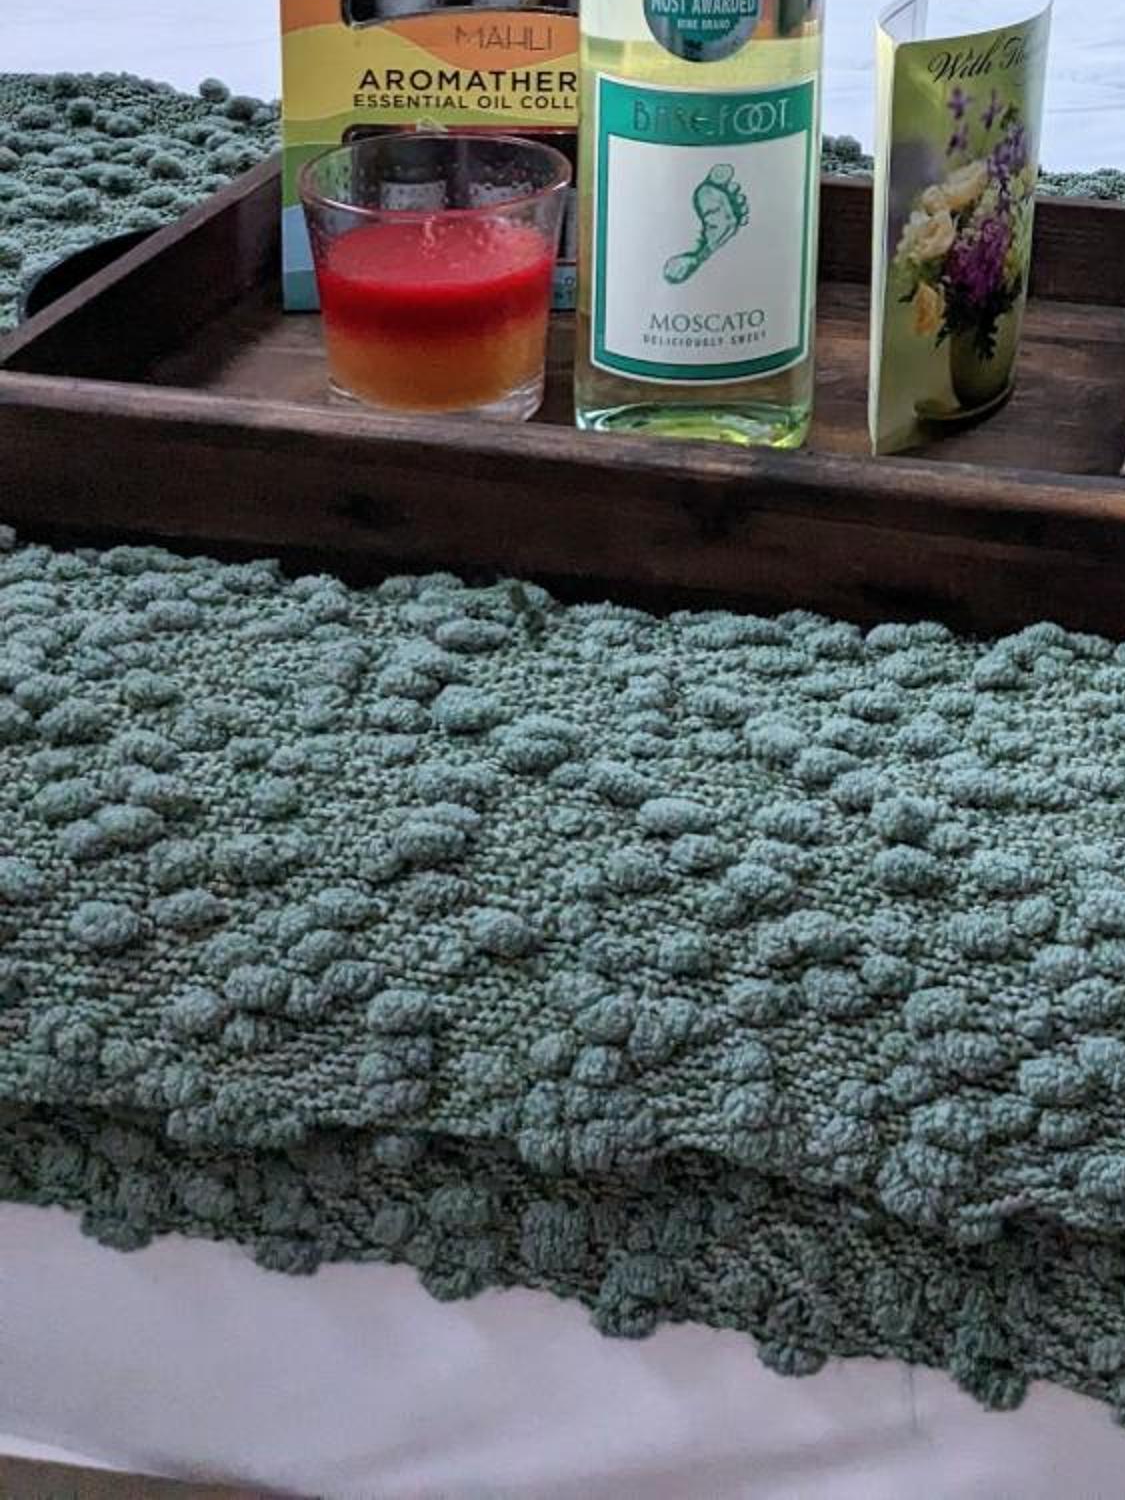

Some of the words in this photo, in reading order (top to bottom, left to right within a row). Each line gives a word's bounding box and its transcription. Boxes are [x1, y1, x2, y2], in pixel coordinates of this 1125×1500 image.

[454, 24, 553, 52] MAHLI
[358, 68, 578, 93] AROMATHER
[352, 93, 469, 110] ESSENTIAL
[476, 94, 513, 110] OIL
[649, 308, 766, 333] MOSCATO
